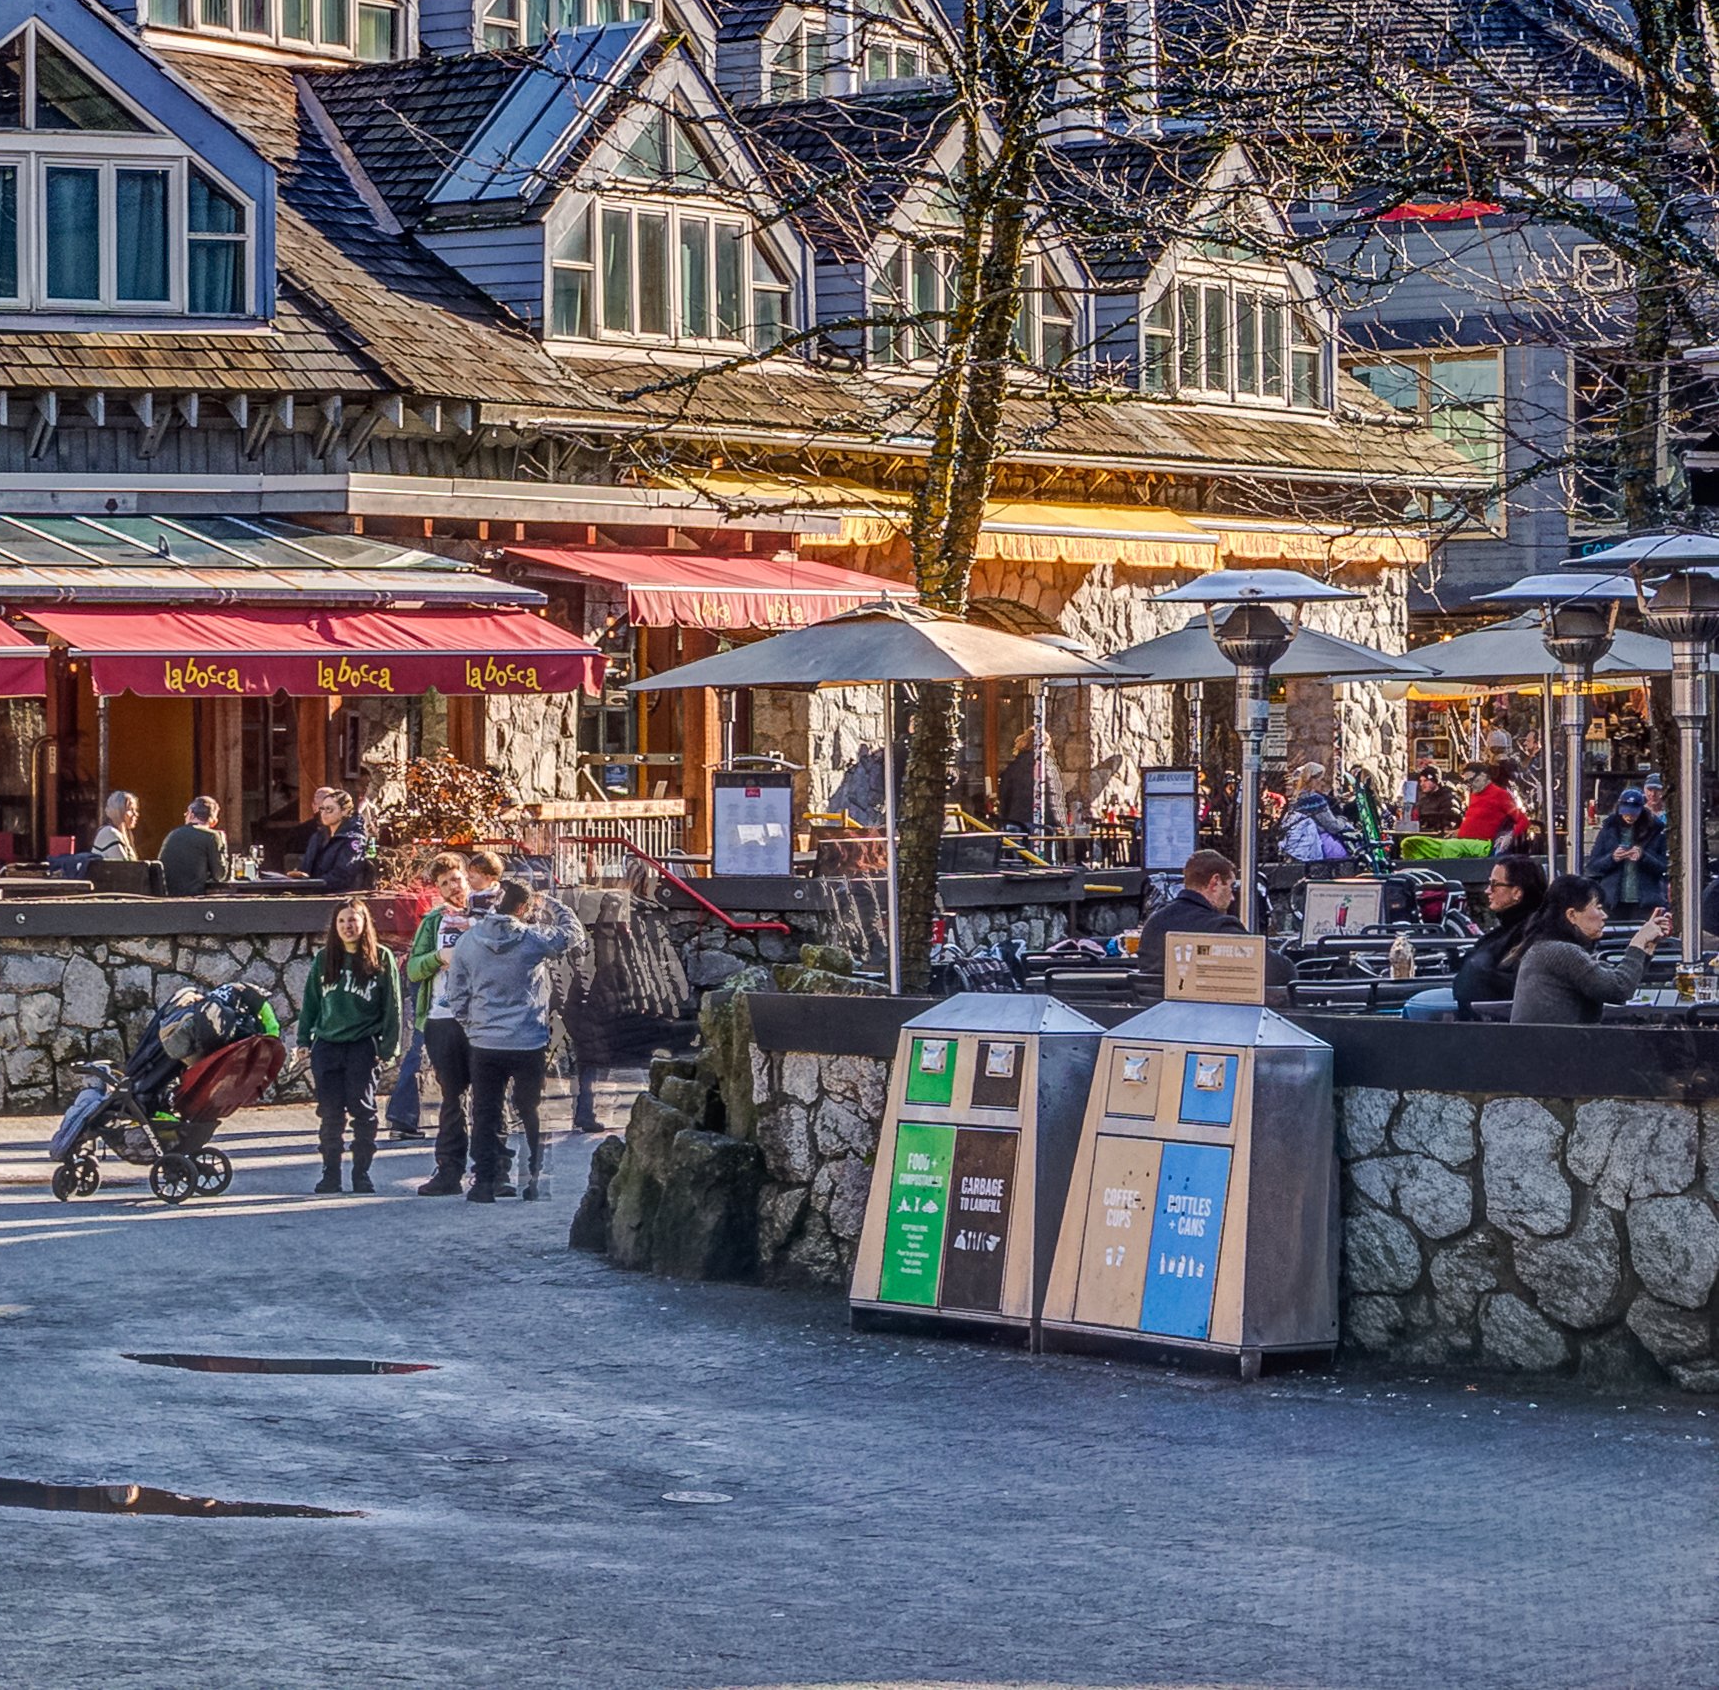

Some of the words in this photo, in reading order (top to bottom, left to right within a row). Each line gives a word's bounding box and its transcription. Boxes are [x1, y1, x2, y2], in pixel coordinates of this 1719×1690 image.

[907, 1152, 930, 1171] FOOD
[961, 1176, 1005, 1197] GARBAGE
[960, 1197, 969, 1211] TO
[970, 1197, 1001, 1213] LANDFILL
[1103, 1187, 1141, 1209] COFFEE
[1167, 1195, 1212, 1217] BOTTLES
[1106, 1209, 1132, 1229] CUPS
[1177, 1216, 1205, 1238] CANS
